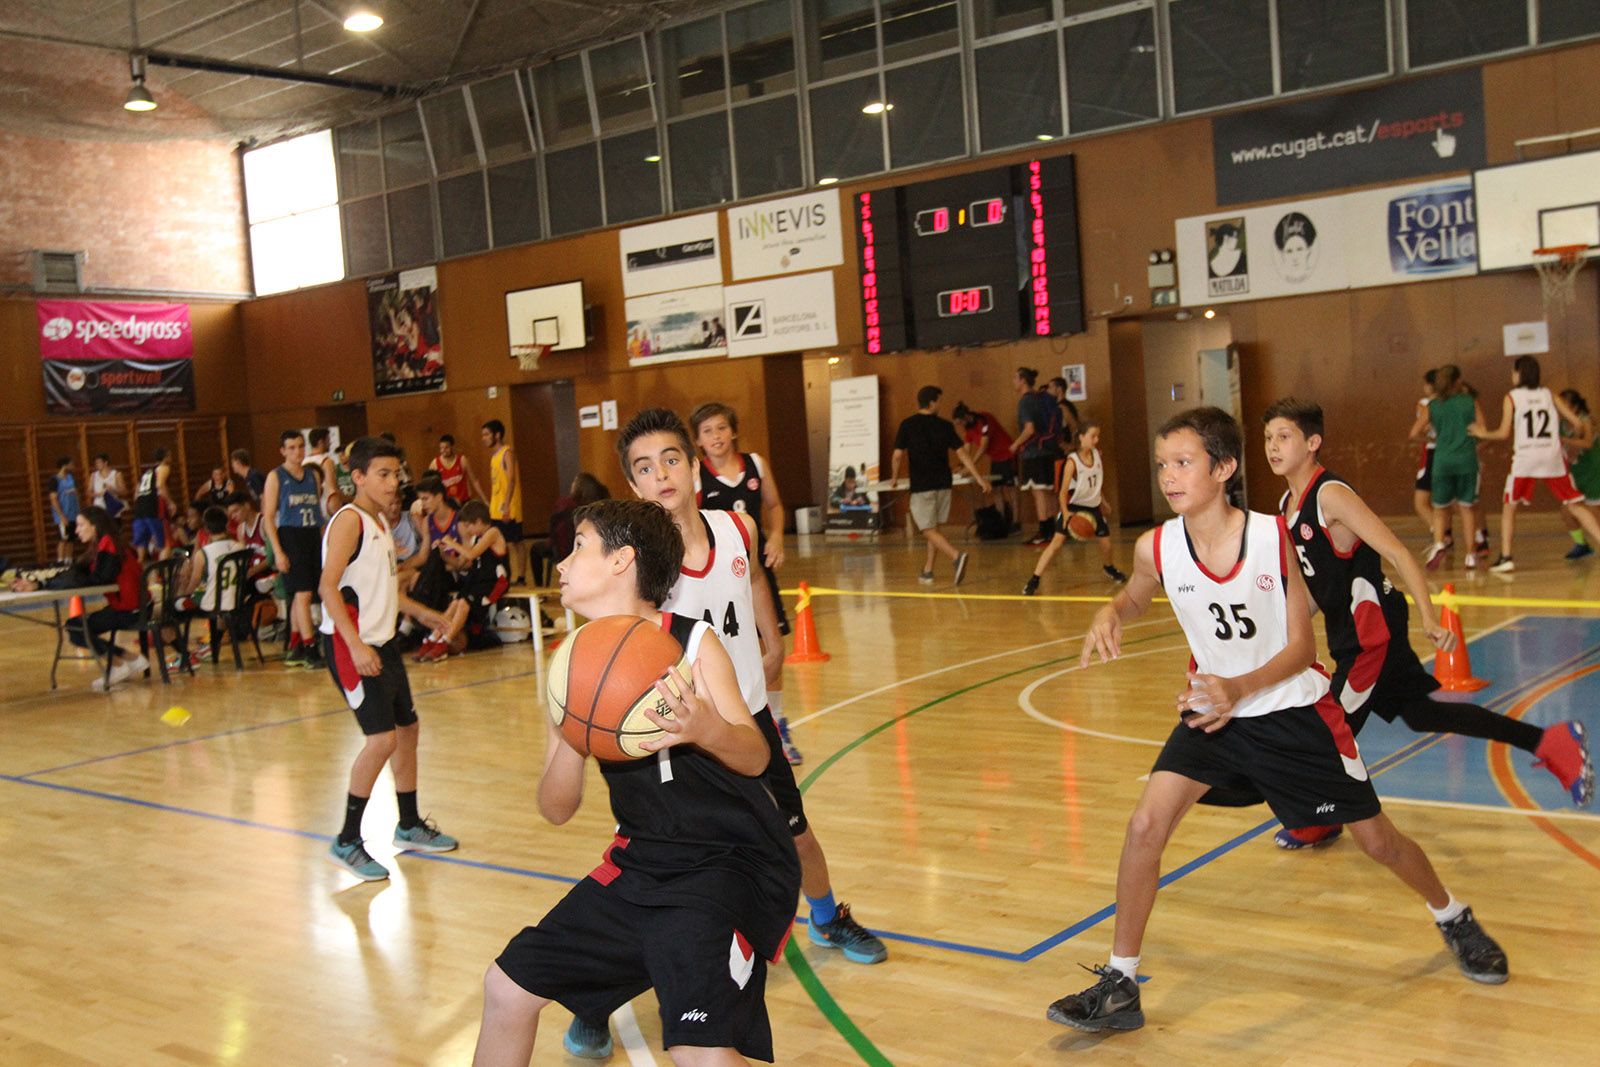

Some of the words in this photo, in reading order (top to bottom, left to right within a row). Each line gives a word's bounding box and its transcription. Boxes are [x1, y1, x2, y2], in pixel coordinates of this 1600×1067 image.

[1231, 112, 1464, 164] www.cugat.cat/esports
[1030, 174, 1041, 190] 5
[738, 204, 826, 240] INNEVIS
[861, 205, 872, 219] 5
[934, 207, 948, 232] 0
[987, 199, 1002, 223] 0
[1396, 196, 1473, 232] Font
[1032, 218, 1044, 233] 8
[1396, 227, 1475, 262] Vella
[950, 289, 980, 314] 0:0
[75, 315, 182, 344] speedgrass
[1523, 409, 1551, 438] 12
[1088, 475, 1097, 488] 17
[1178, 583, 1196, 593] vive
[1208, 602, 1257, 640] 35
[1316, 803, 1335, 814] vive
[680, 1008, 708, 1022] vive
